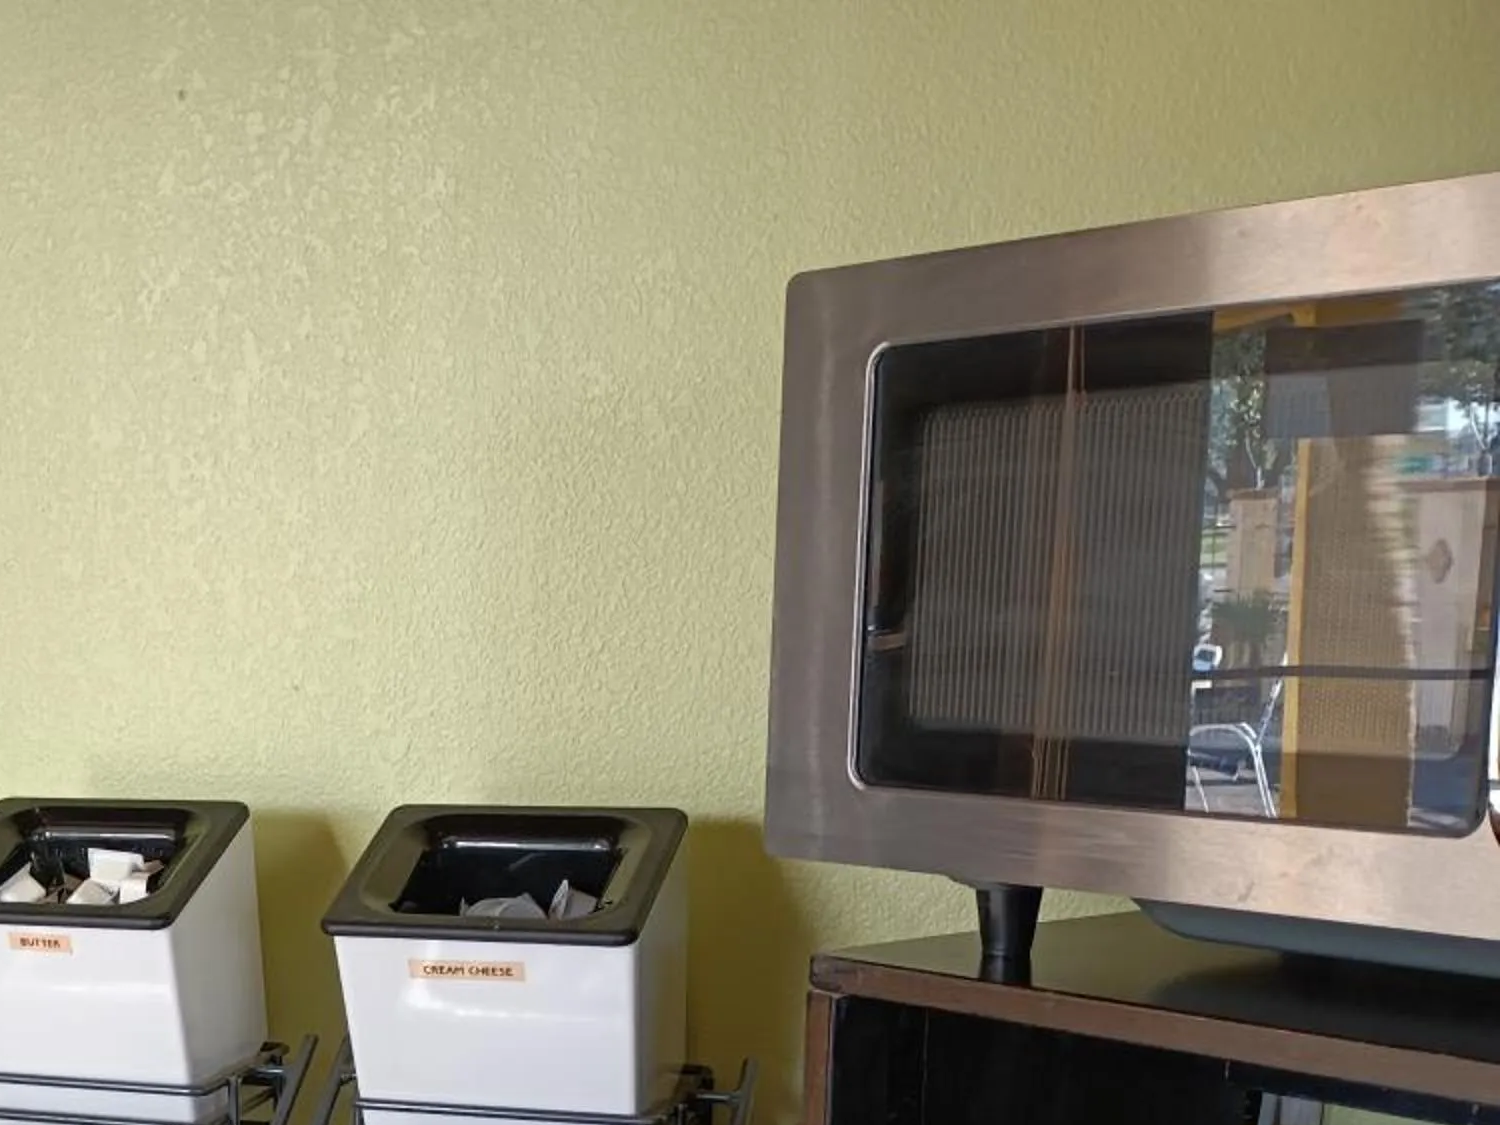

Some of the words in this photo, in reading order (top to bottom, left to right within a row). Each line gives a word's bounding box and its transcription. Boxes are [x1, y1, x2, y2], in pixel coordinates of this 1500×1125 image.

[19, 937, 61, 949] BUTTER
[423, 965, 465, 976] CREAM
[468, 966, 514, 977] CHEESE
